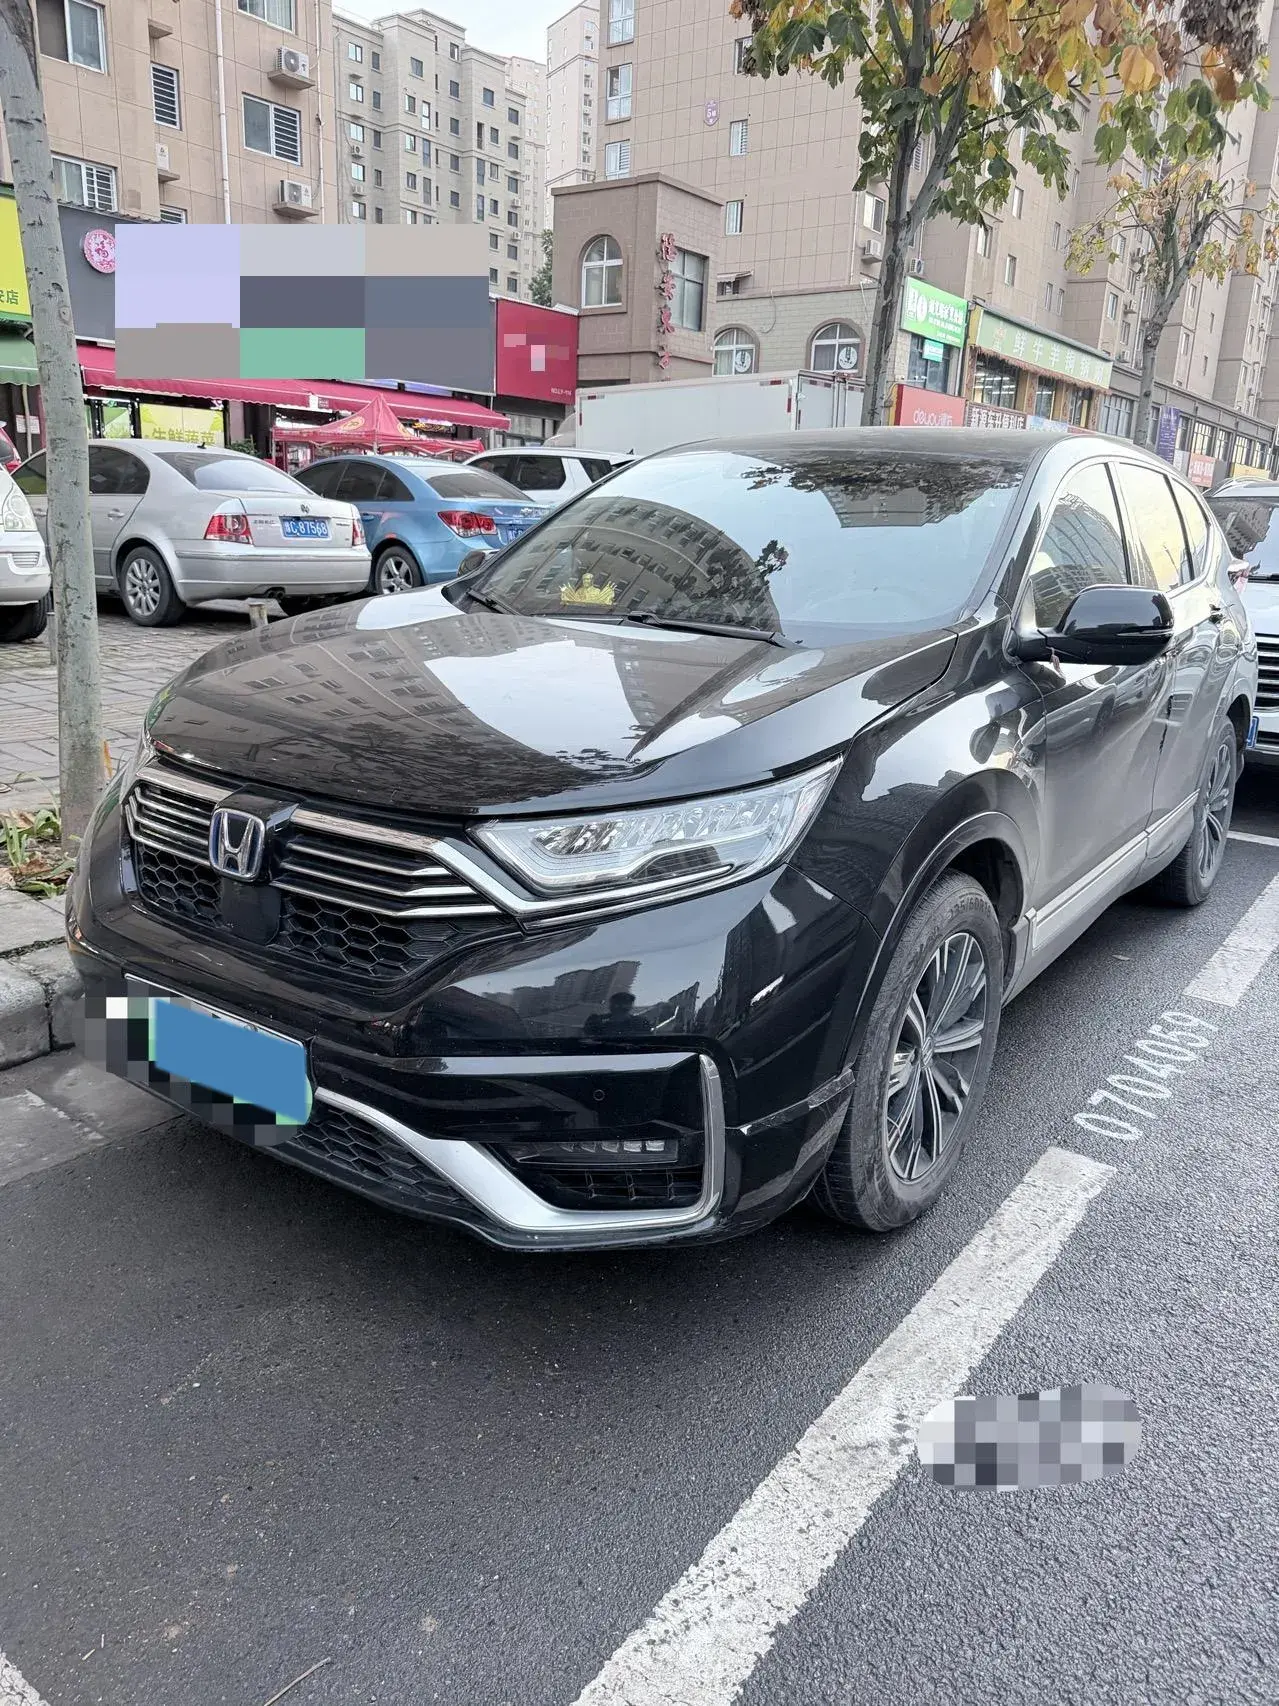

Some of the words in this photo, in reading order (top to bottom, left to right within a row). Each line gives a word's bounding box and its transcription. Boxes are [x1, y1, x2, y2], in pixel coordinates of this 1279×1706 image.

[0, 290, 19, 305] 店
[152, 427, 216, 447] 生鲜蔬菜
[1073, 1011, 1219, 1141] 0704059
